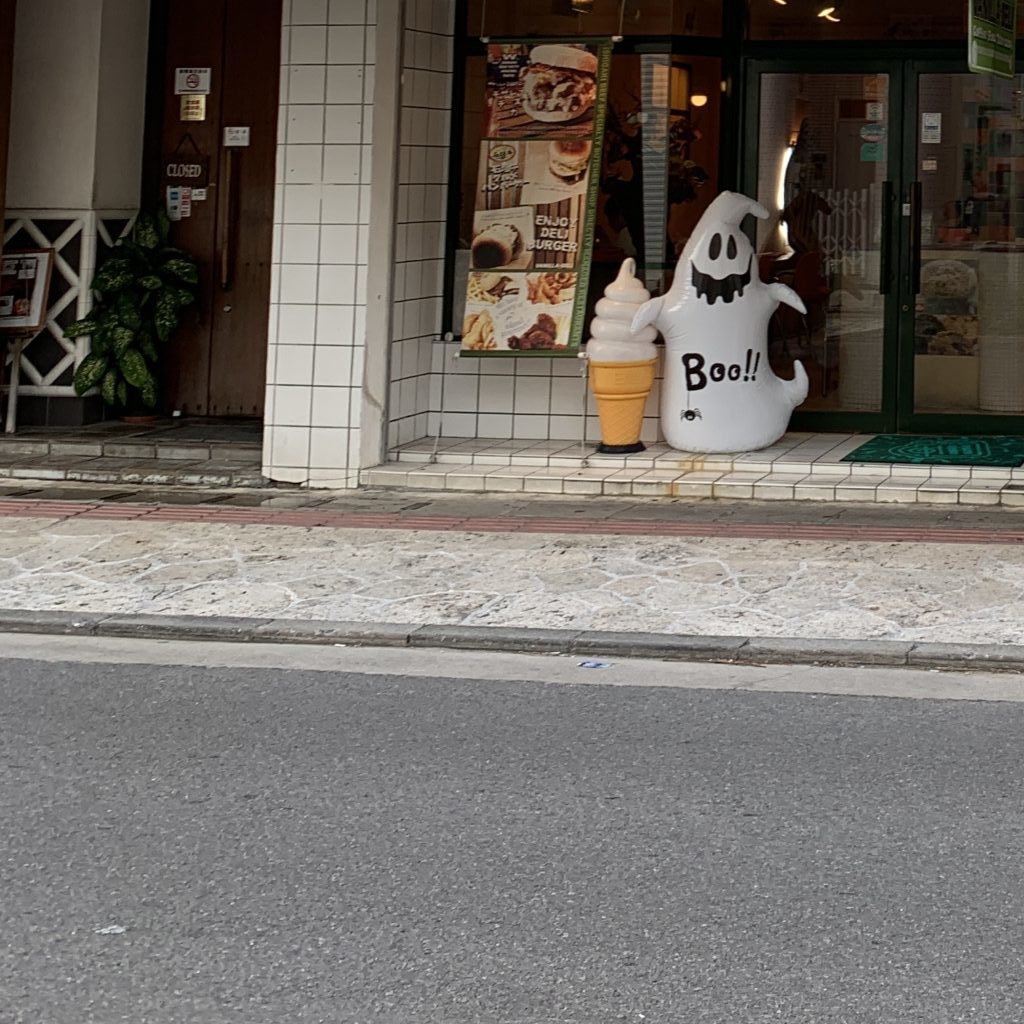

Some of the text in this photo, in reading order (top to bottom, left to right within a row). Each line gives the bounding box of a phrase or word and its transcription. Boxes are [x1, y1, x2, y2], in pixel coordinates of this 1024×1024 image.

[166, 163, 202, 178] CLOSED
[535, 215, 578, 227] ENJOY
[682, 349, 761, 392] Boo!!
